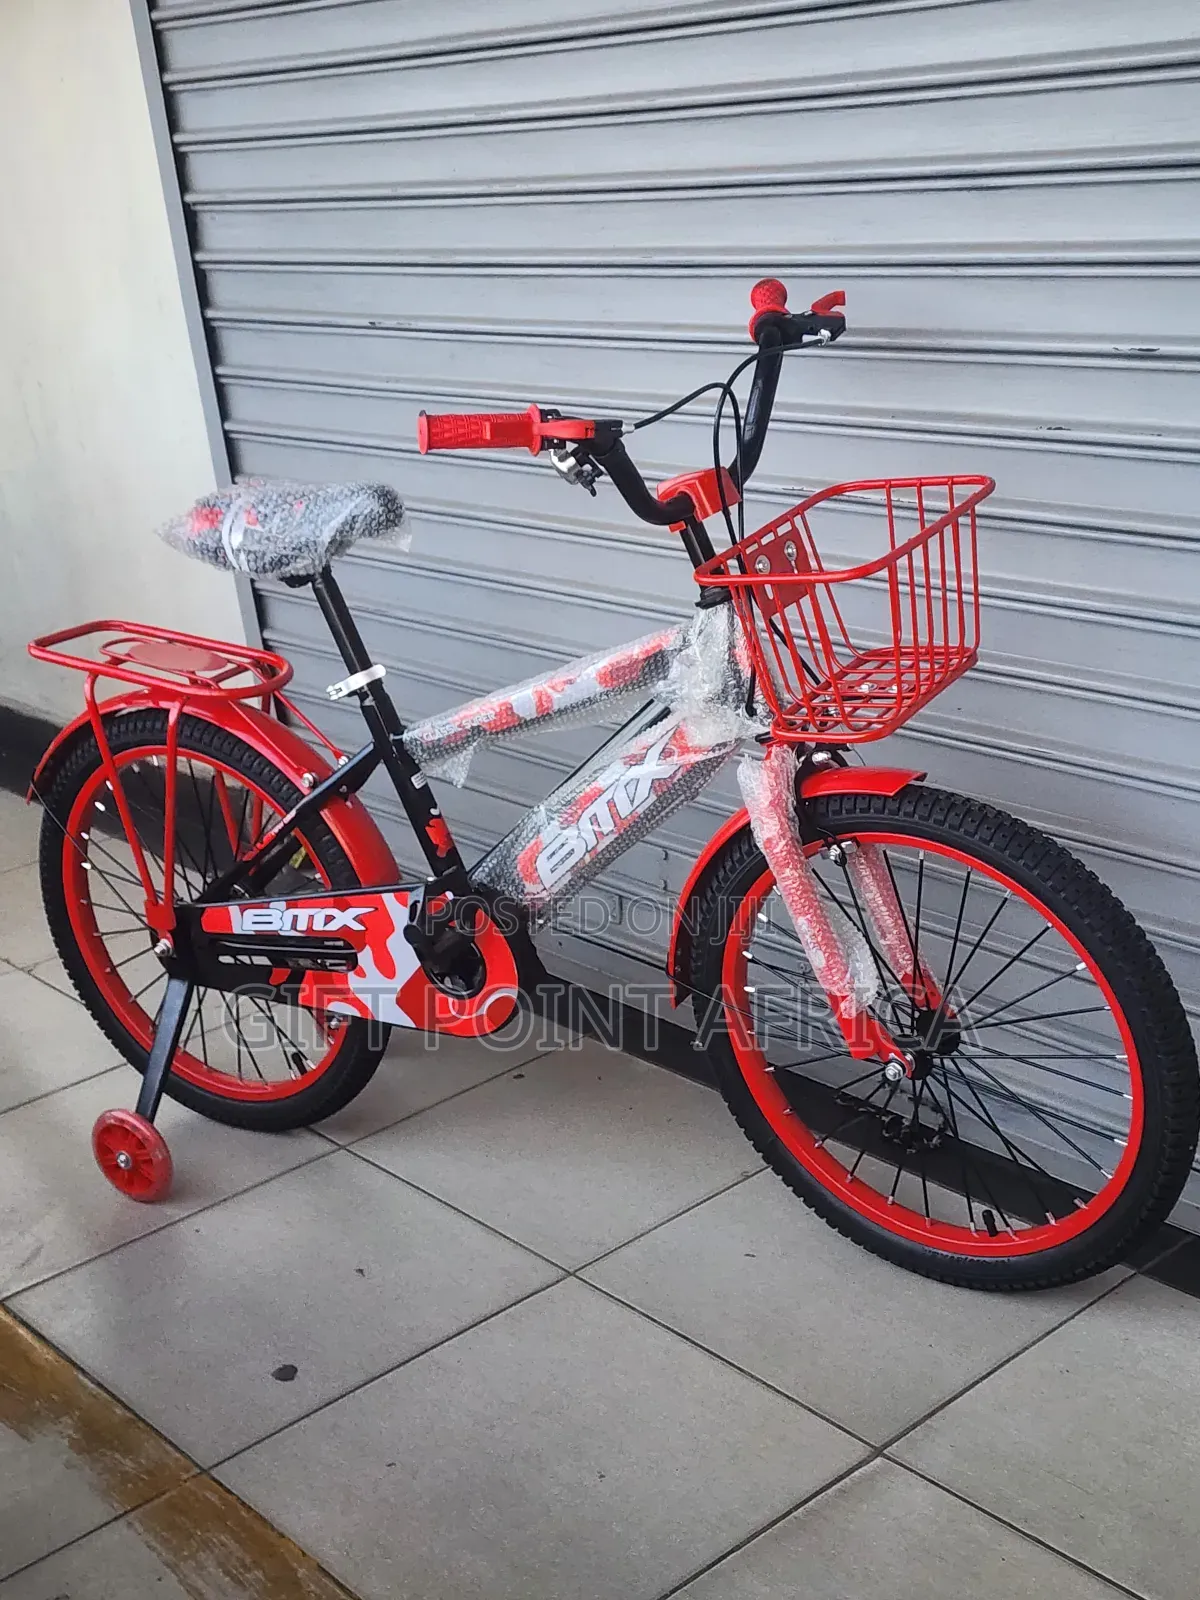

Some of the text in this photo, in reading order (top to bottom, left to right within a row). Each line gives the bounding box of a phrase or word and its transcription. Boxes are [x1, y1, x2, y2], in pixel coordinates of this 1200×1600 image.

[462, 711, 496, 730] SUPER
[536, 724, 681, 890] BMX
[241, 907, 378, 931] BMX
